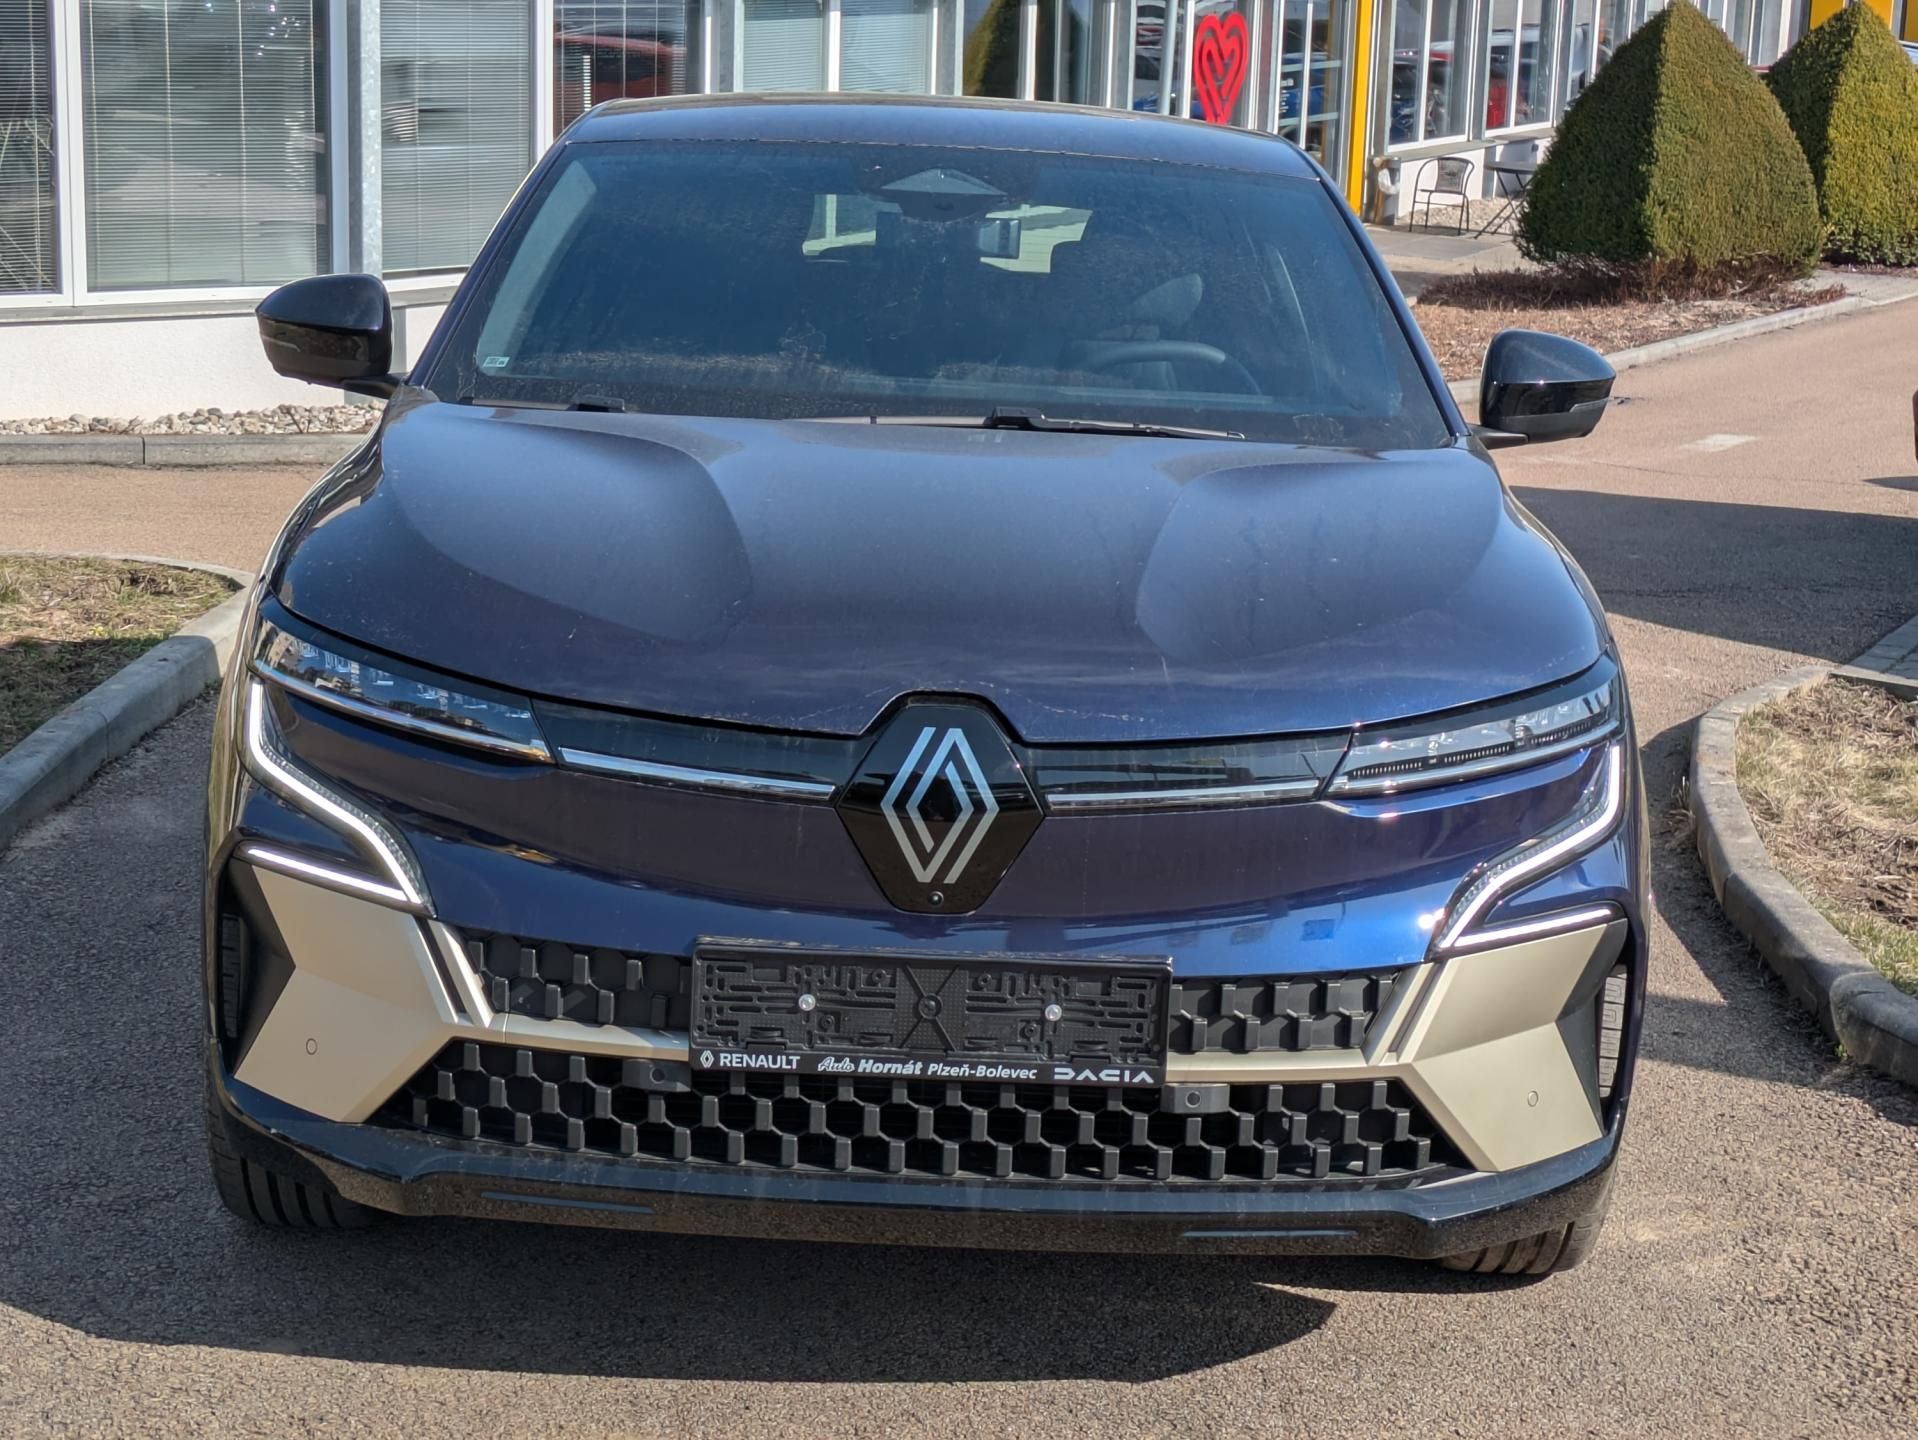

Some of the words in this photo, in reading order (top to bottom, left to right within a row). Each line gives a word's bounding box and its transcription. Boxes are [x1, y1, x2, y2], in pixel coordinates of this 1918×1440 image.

[719, 1053, 801, 1069] RENAULT
[817, 1056, 855, 1072] Auto
[857, 1059, 924, 1075] Hornát
[927, 1063, 1037, 1080] Plzeň-Bolevec
[1053, 1067, 1155, 1084] DACIA
